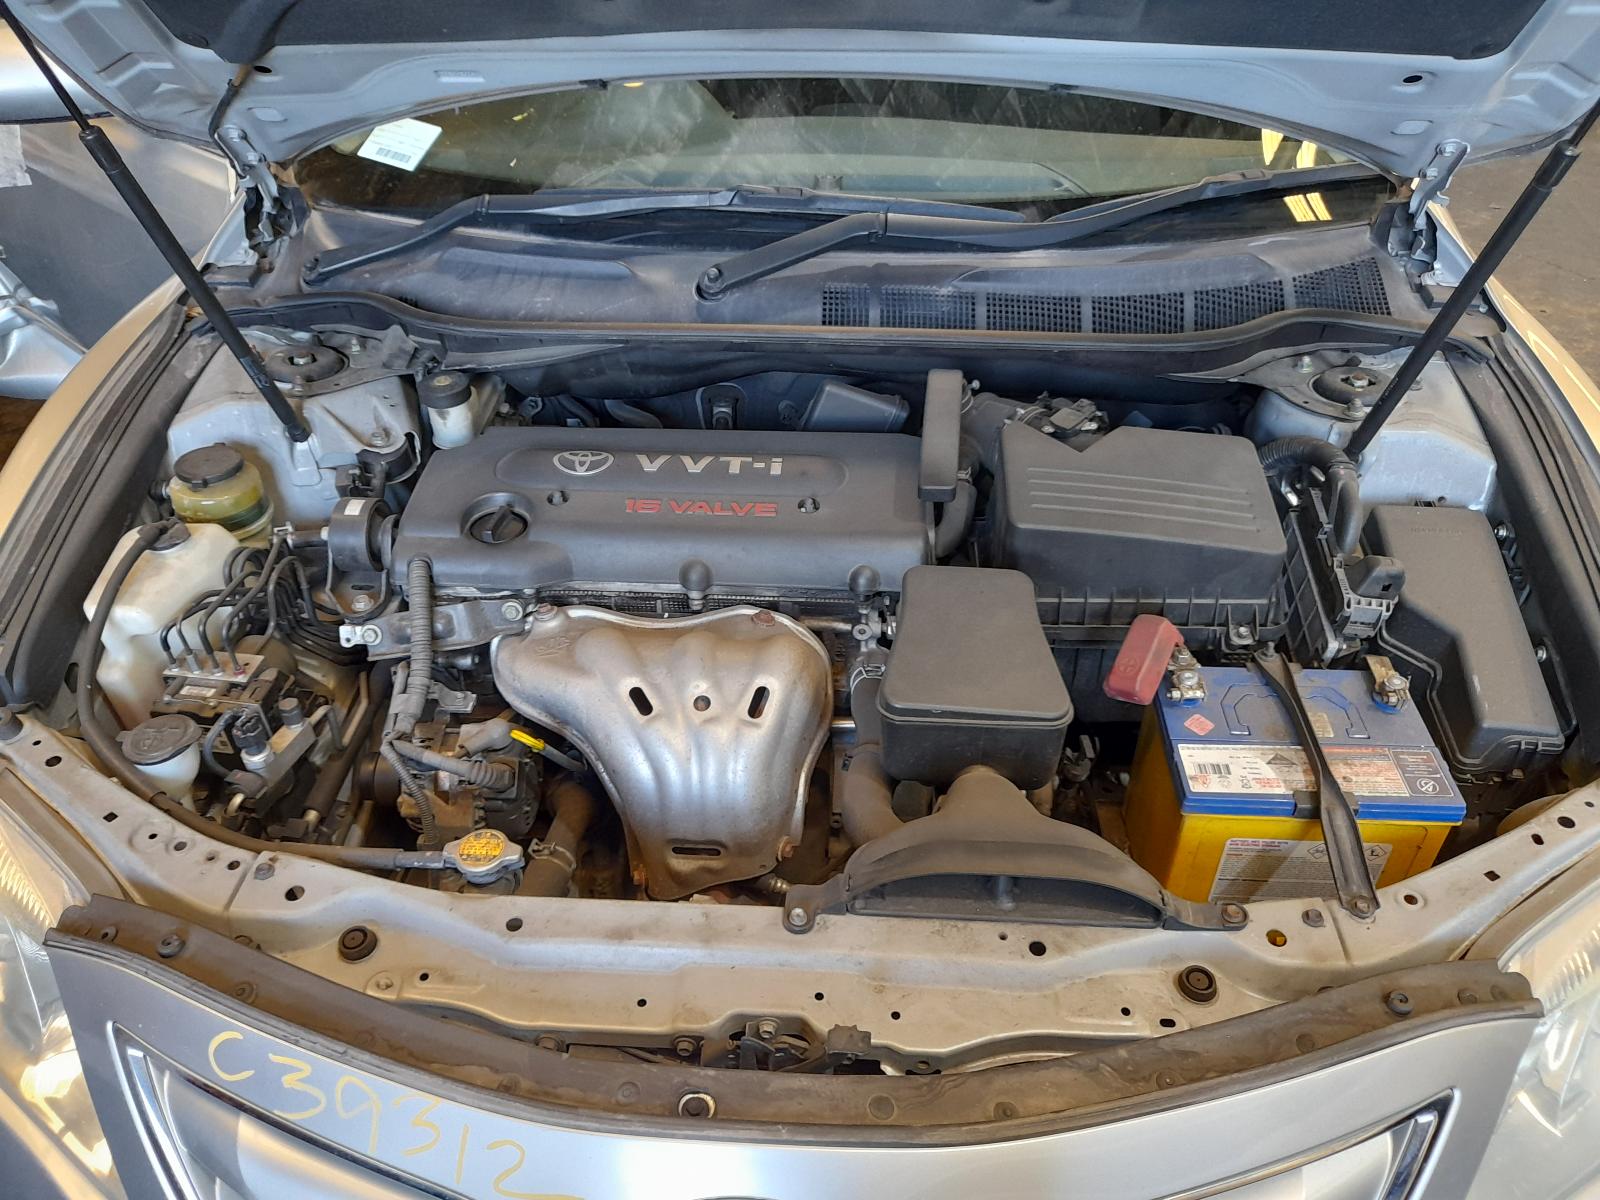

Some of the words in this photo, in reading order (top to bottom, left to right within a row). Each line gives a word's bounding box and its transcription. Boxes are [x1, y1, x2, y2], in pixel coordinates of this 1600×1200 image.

[635, 454, 783, 475] VVT-i
[625, 498, 662, 513] 16
[668, 501, 778, 517] VALVE
[207, 1030, 584, 1200] C39312
